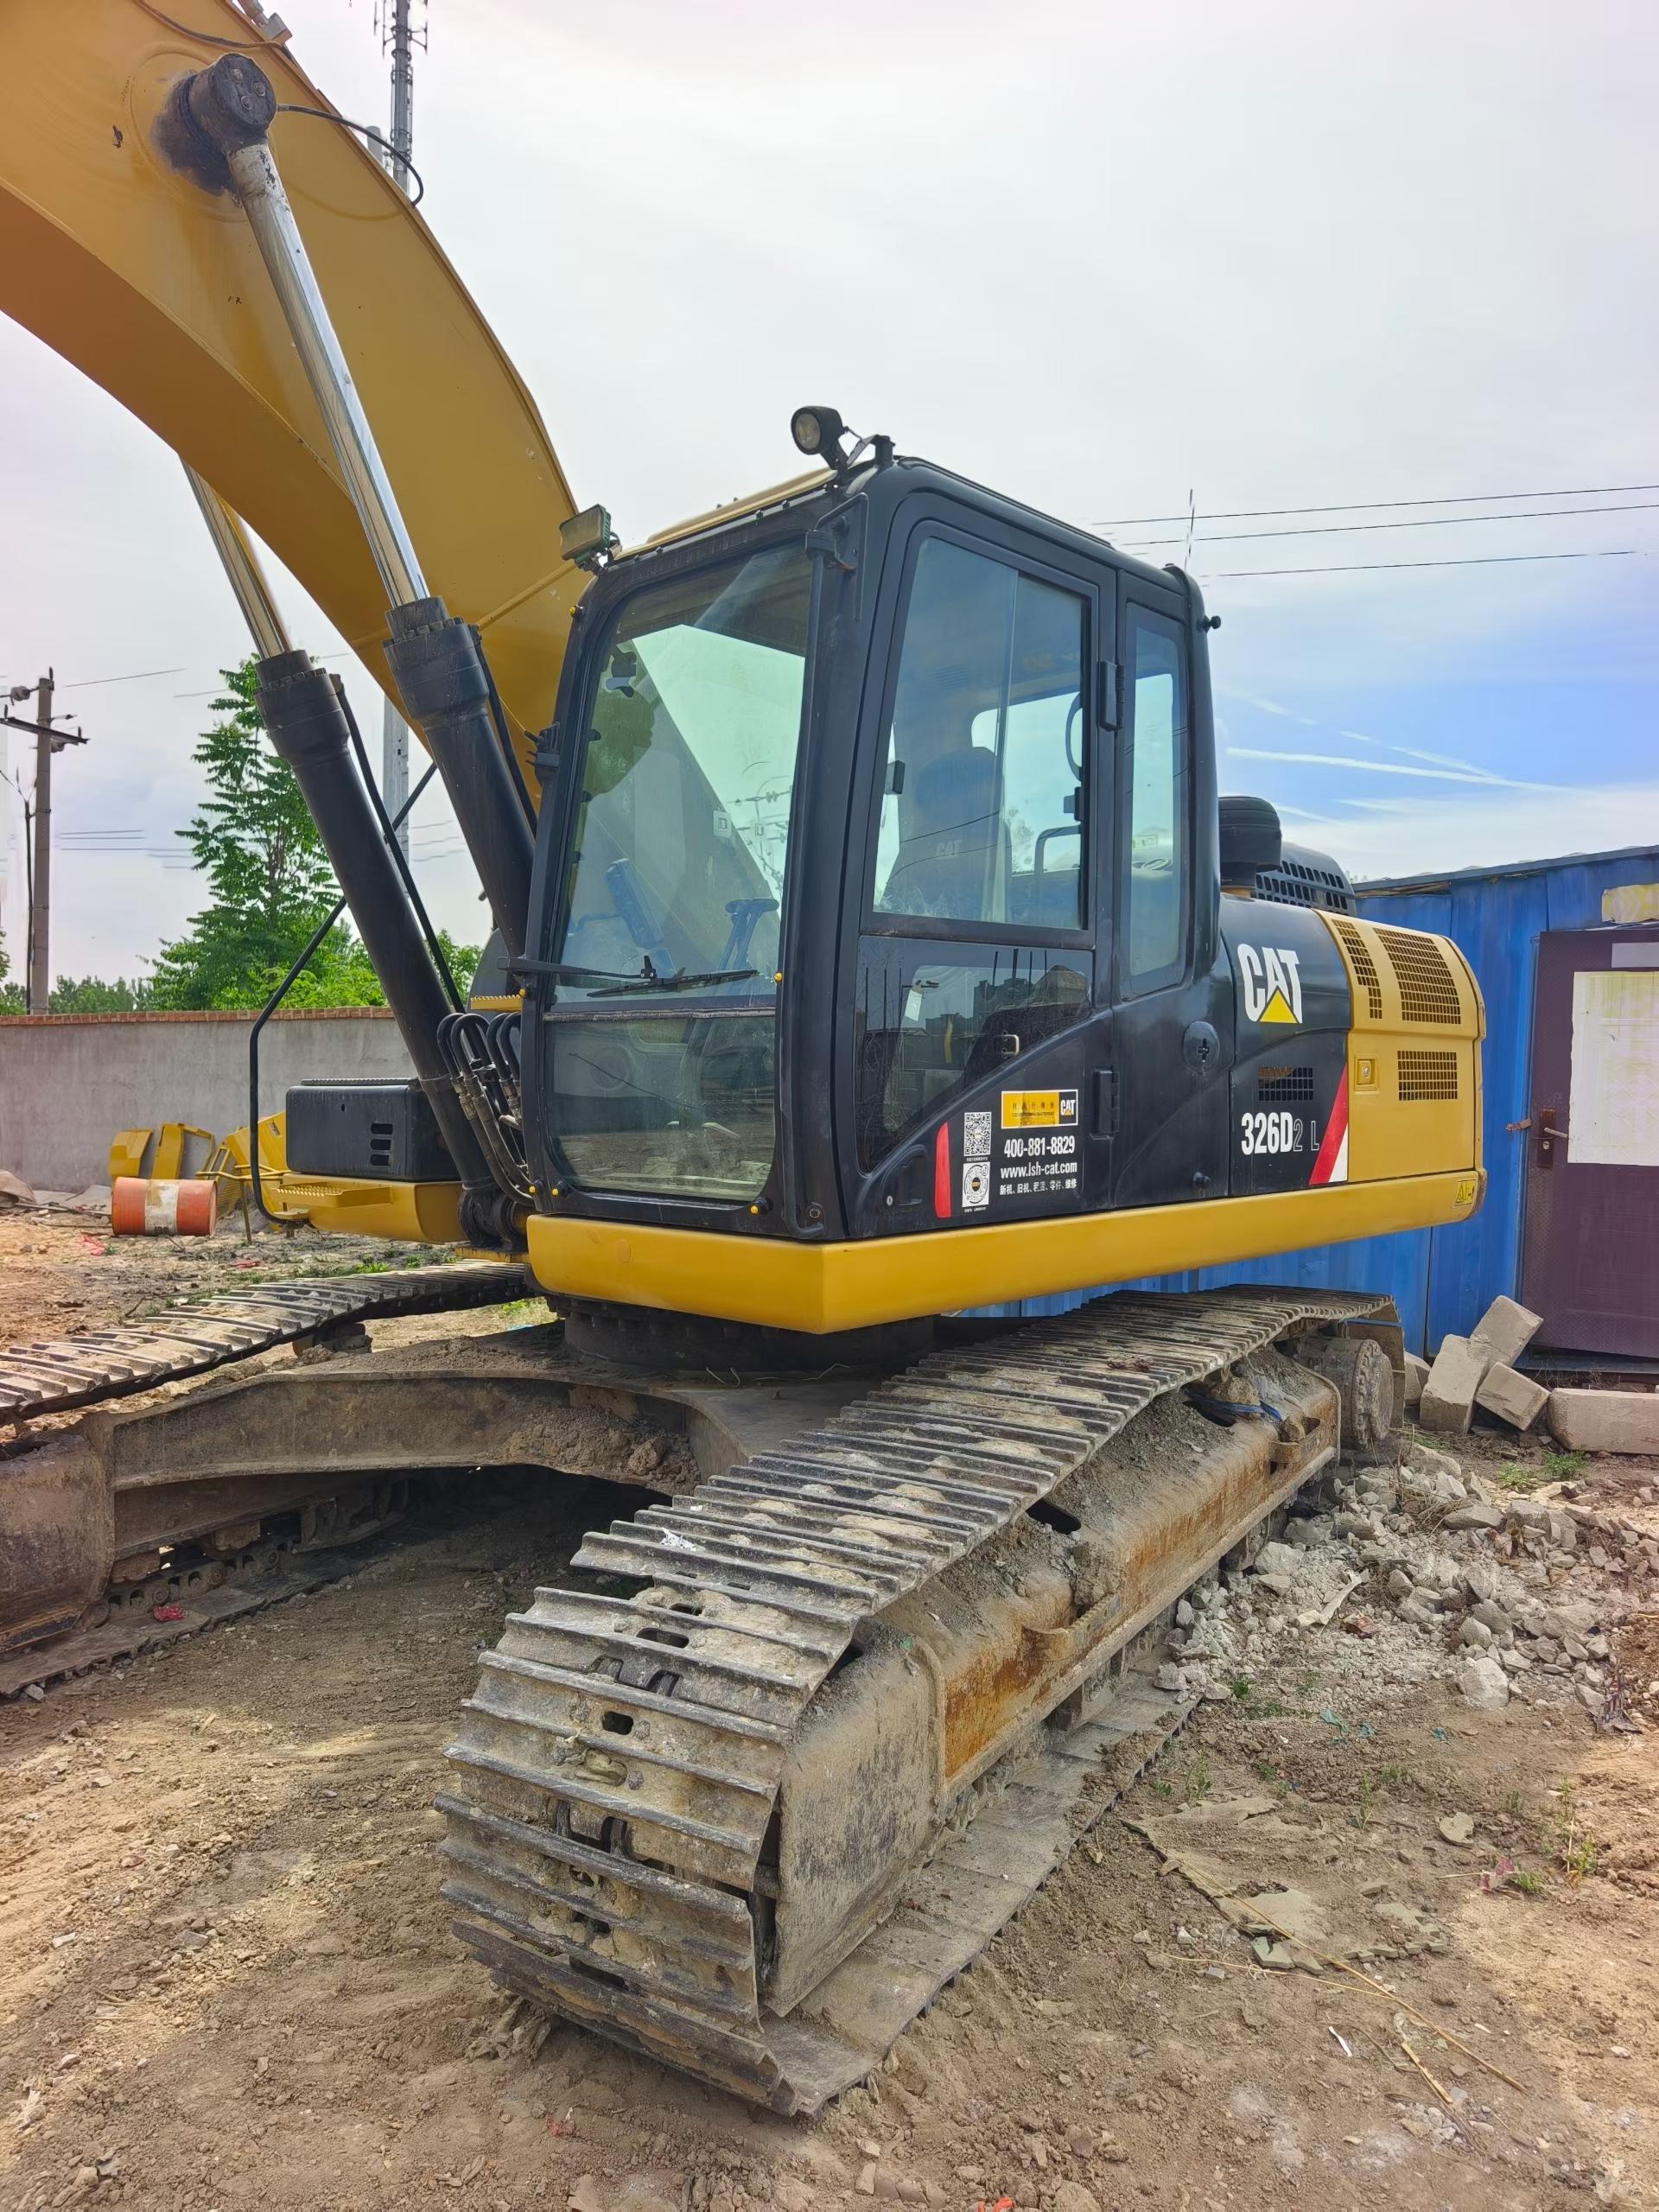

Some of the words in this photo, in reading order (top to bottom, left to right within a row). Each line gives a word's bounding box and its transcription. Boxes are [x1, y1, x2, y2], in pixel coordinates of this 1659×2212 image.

[1237, 944, 1302, 1023] CAT
[1060, 1099, 1076, 1116] CAT
[1241, 1112, 1303, 1155] 326D2
[1311, 1121, 1320, 1151] L
[1004, 1135, 1075, 1158] 400-881-8829
[1001, 1161, 1077, 1179] www.lsh-cat.com
